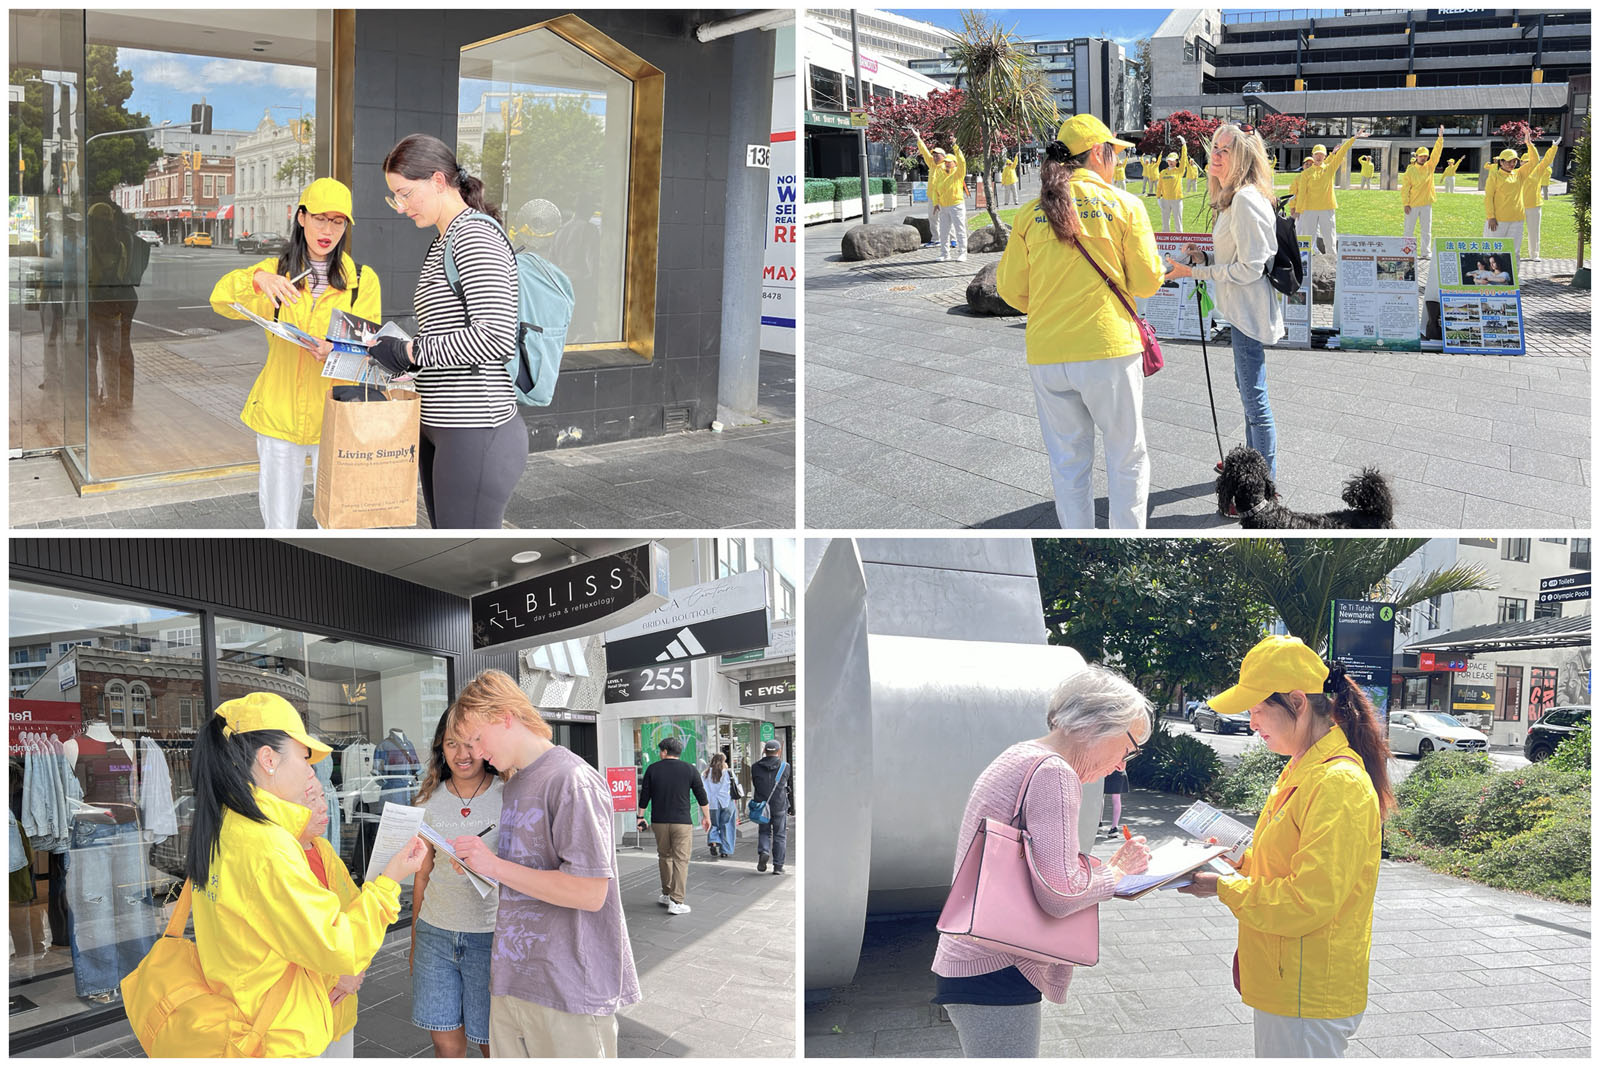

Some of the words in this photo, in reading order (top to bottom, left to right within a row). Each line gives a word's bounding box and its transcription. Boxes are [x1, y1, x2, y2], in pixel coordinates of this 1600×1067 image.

[762, 292, 782, 300] 8478
[338, 449, 373, 460] Living
[376, 448, 409, 458] Simply
[526, 568, 622, 613] BLISS
[1554, 592, 1574, 600] Olympic
[572, 596, 615, 612] reflexology
[642, 618, 670, 629] BRIDAL
[672, 607, 717, 623] BOUTIQUE
[1340, 611, 1375, 619] Newmarket
[640, 667, 684, 691] 255
[758, 685, 784, 696] EYIS
[612, 780, 632, 792] 30%
